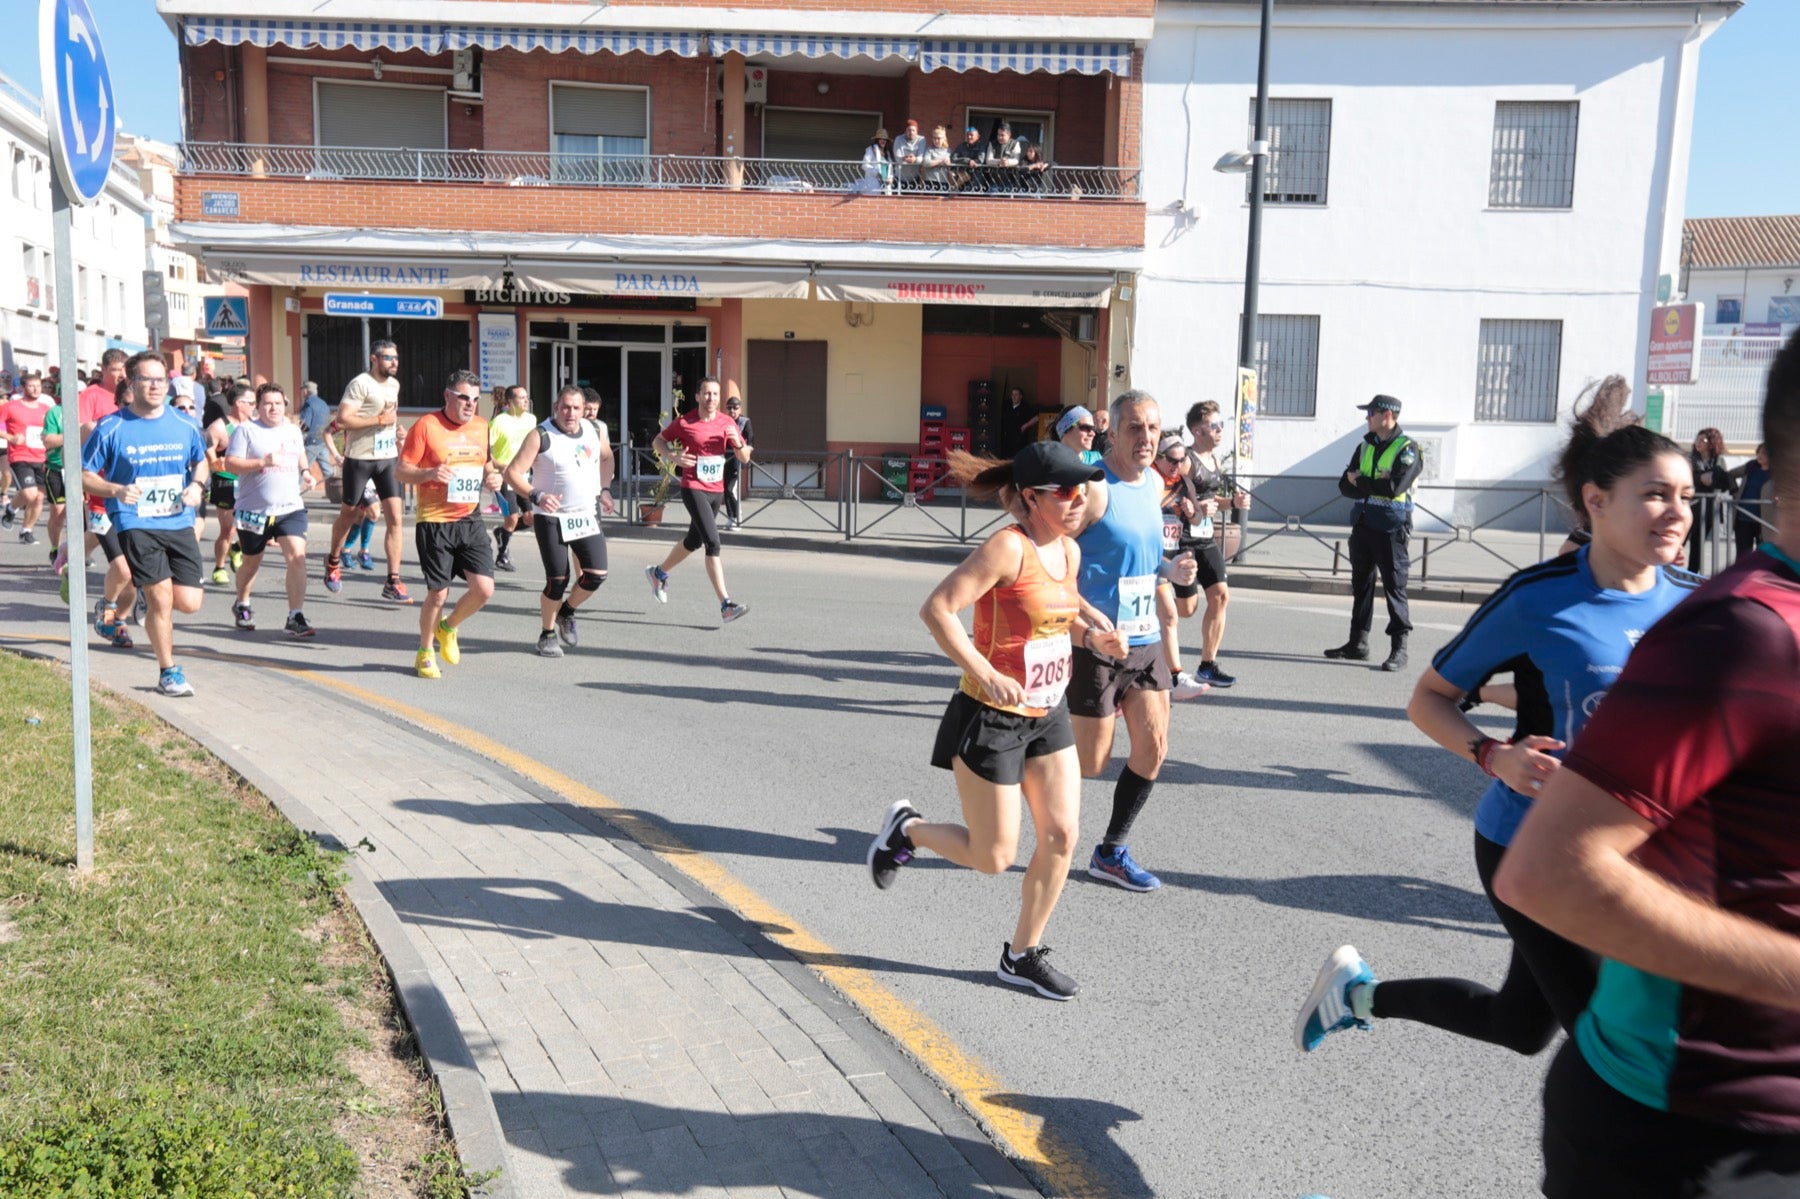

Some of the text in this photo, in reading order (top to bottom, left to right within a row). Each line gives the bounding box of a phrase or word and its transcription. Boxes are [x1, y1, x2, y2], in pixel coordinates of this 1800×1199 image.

[301, 264, 449, 285] RESTAURANTE
[615, 273, 700, 291] PARADA
[328, 300, 375, 311] Granada
[702, 463, 722, 475] 987
[456, 478, 482, 492] 382
[146, 487, 178, 504] 476
[567, 517, 590, 530] 801
[1132, 594, 1156, 618] 17
